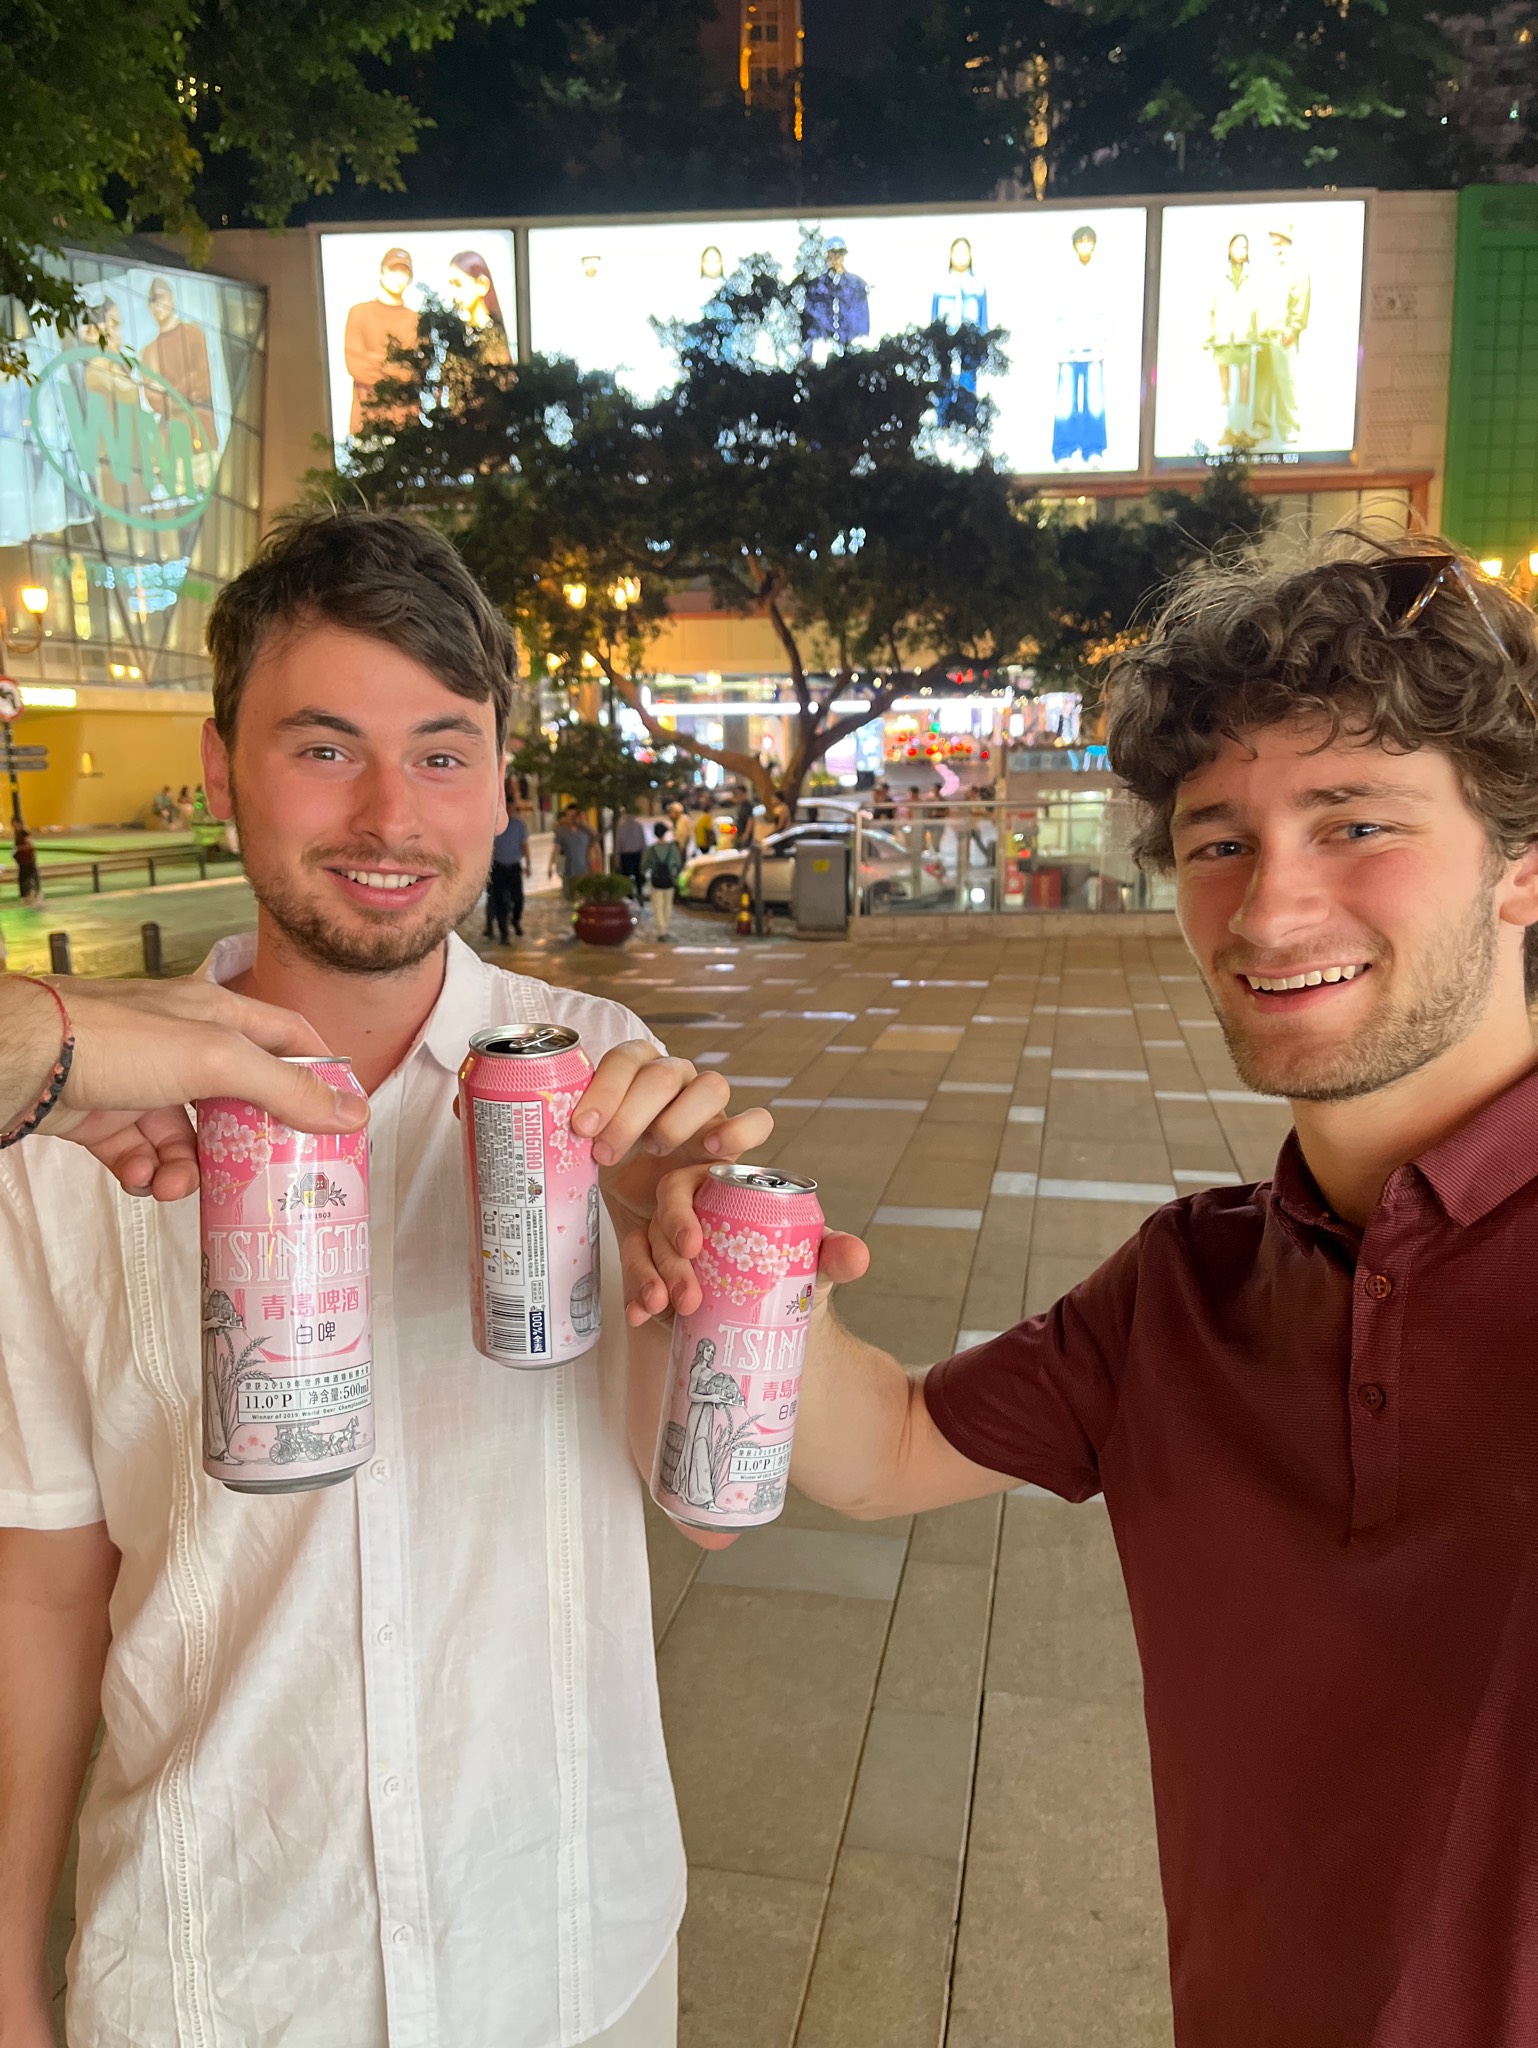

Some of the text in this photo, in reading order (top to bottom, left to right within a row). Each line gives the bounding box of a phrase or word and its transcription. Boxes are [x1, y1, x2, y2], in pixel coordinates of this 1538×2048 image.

[524, 1105, 543, 1170] TSINGTAO
[296, 1321, 336, 1345] 白啤
[252, 1412, 273, 1420] Winner
[302, 1409, 320, 1417] World
